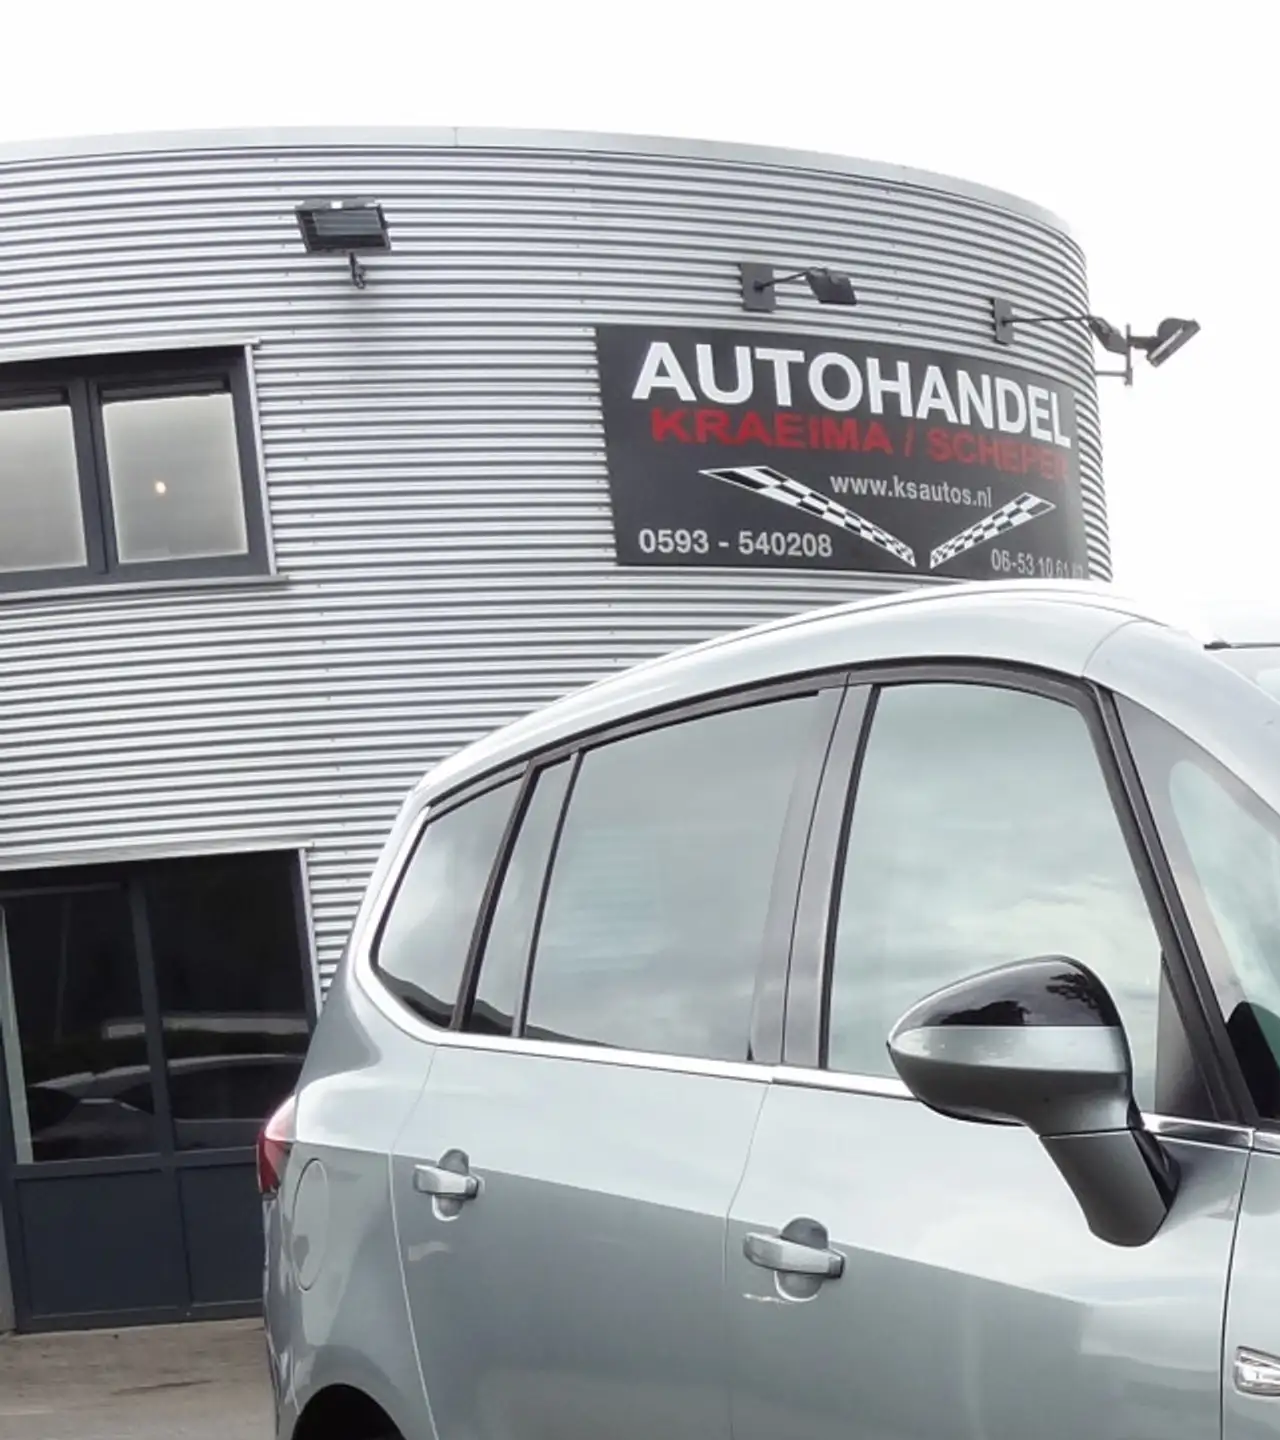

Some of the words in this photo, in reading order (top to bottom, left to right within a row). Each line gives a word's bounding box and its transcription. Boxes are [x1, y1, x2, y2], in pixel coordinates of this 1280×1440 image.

[631, 341, 1071, 449] AUTOHANDEL
[651, 407, 893, 455] KRAEIMA
[904, 431, 915, 458] /
[927, 428, 1069, 482] SCHEPER
[829, 474, 993, 509] www.ksautos.nl
[638, 528, 710, 555] 0593
[738, 530, 833, 558] 540208
[990, 547, 1036, 576] 06-53
